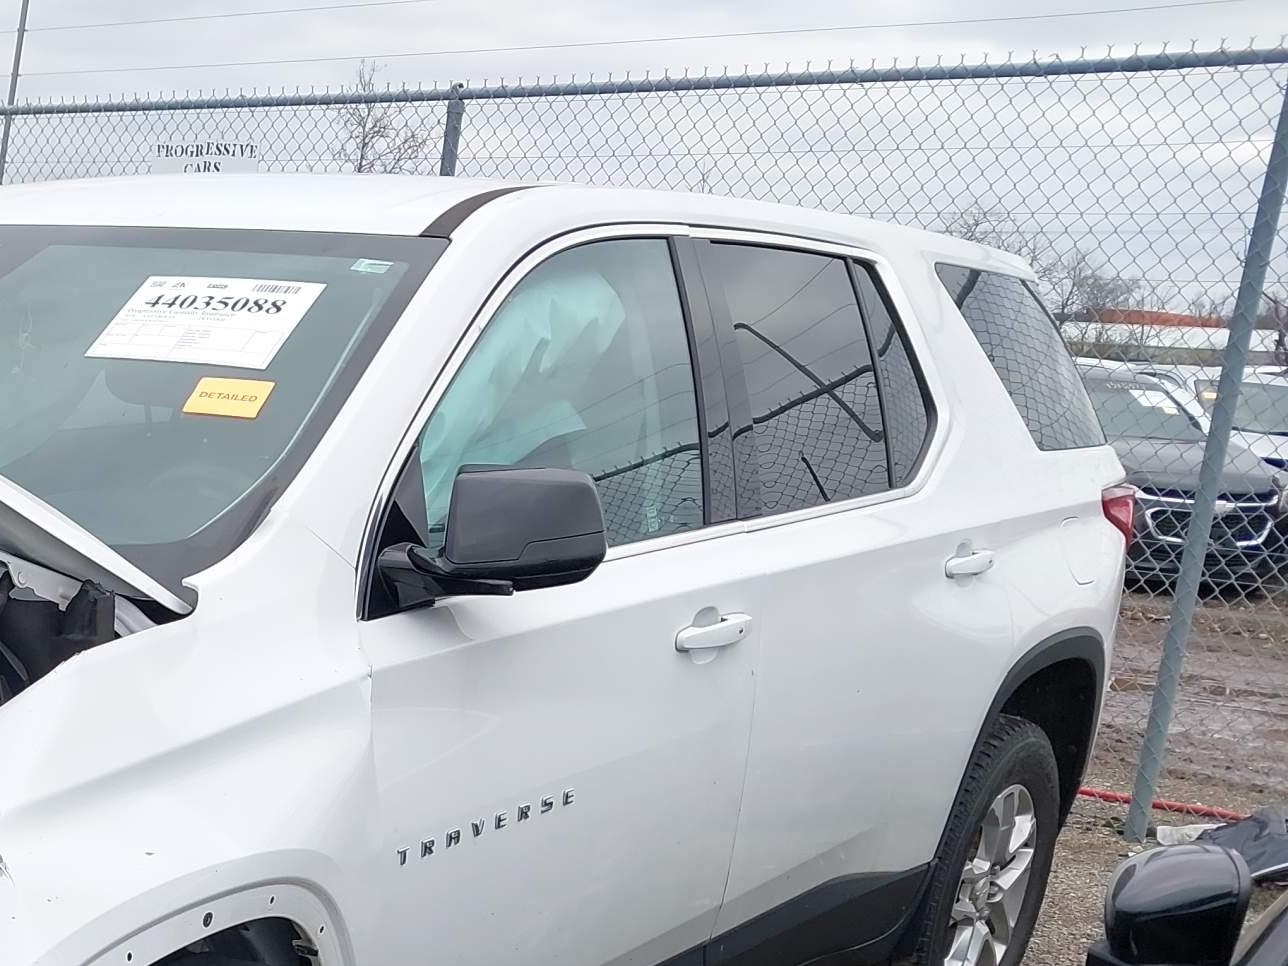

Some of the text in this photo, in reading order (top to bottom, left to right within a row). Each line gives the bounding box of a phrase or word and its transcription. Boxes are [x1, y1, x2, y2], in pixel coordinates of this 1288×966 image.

[156, 142, 258, 159] PROGRESSIVE
[183, 160, 221, 173] CARS
[144, 293, 287, 315] 44035088
[198, 390, 258, 402] DETAILED
[396, 787, 575, 866] TRAVERSE
